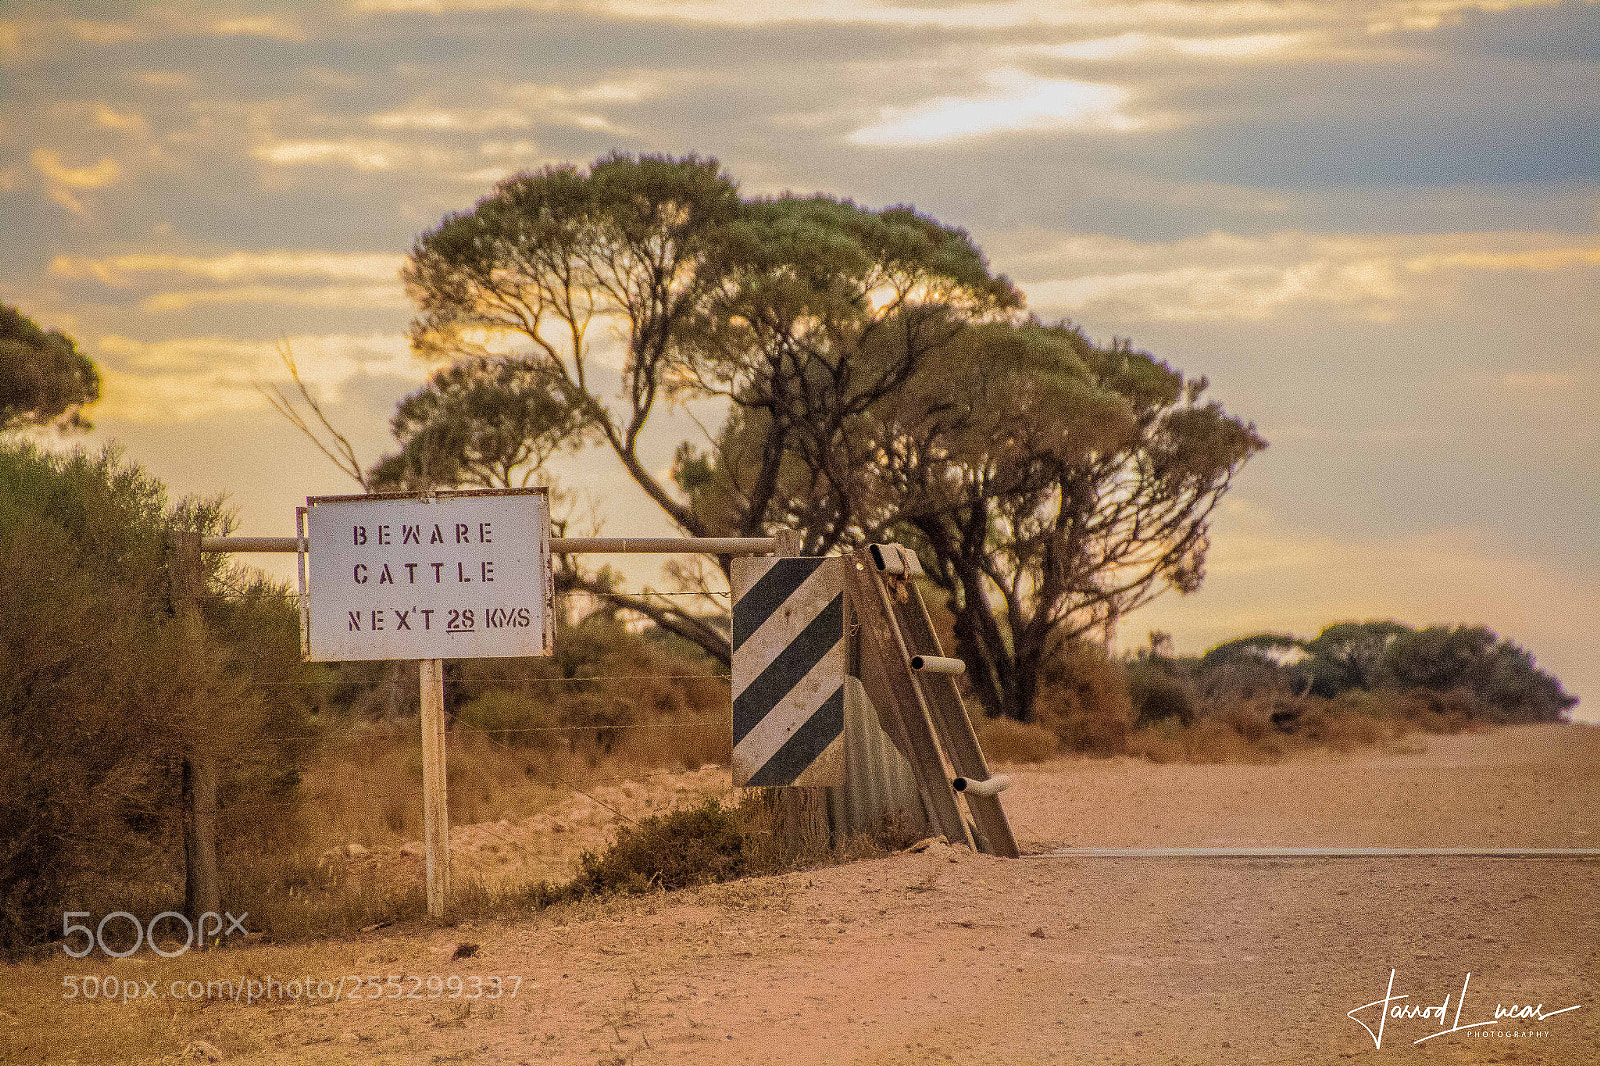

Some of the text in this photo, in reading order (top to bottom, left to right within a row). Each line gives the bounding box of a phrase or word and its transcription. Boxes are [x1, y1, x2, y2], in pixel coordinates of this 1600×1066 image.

[353, 522, 492, 546] BEWARE
[353, 561, 494, 584] CATTLE
[446, 608, 475, 633] 28
[485, 607, 531, 629] KMS
